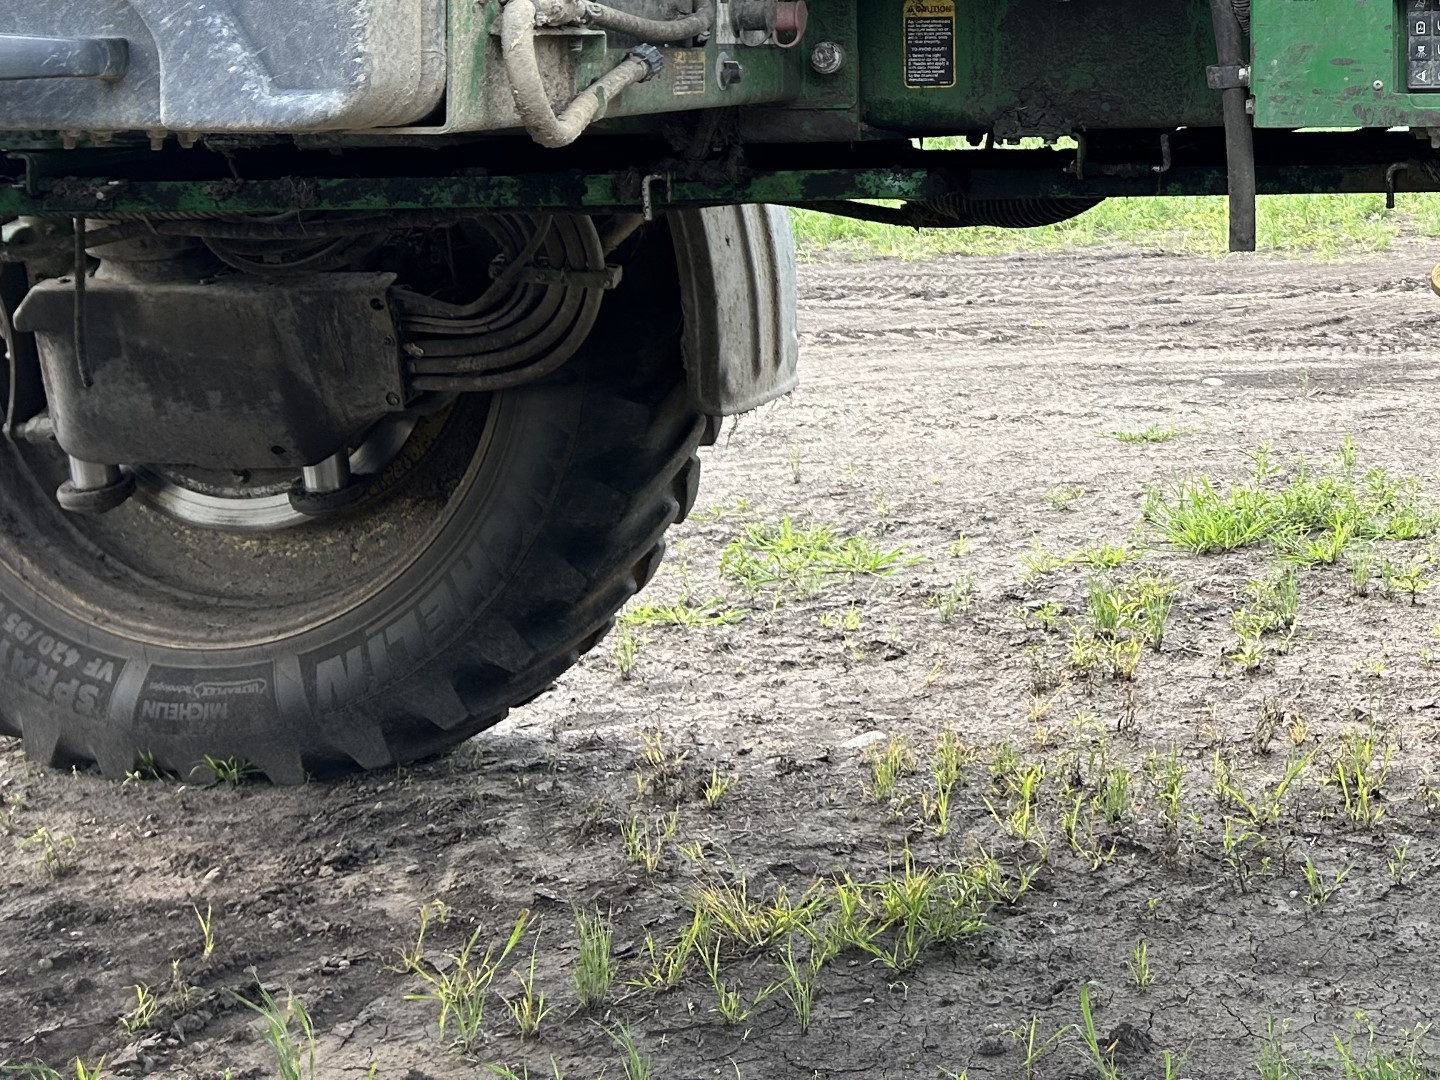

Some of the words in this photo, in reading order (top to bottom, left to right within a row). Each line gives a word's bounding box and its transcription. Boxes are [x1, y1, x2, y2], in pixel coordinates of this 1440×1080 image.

[1, 612, 81, 668] 420/95
[82, 657, 114, 683] VF
[200, 682, 260, 697] ULTRAFLEX
[141, 699, 229, 722] MICHELIN
